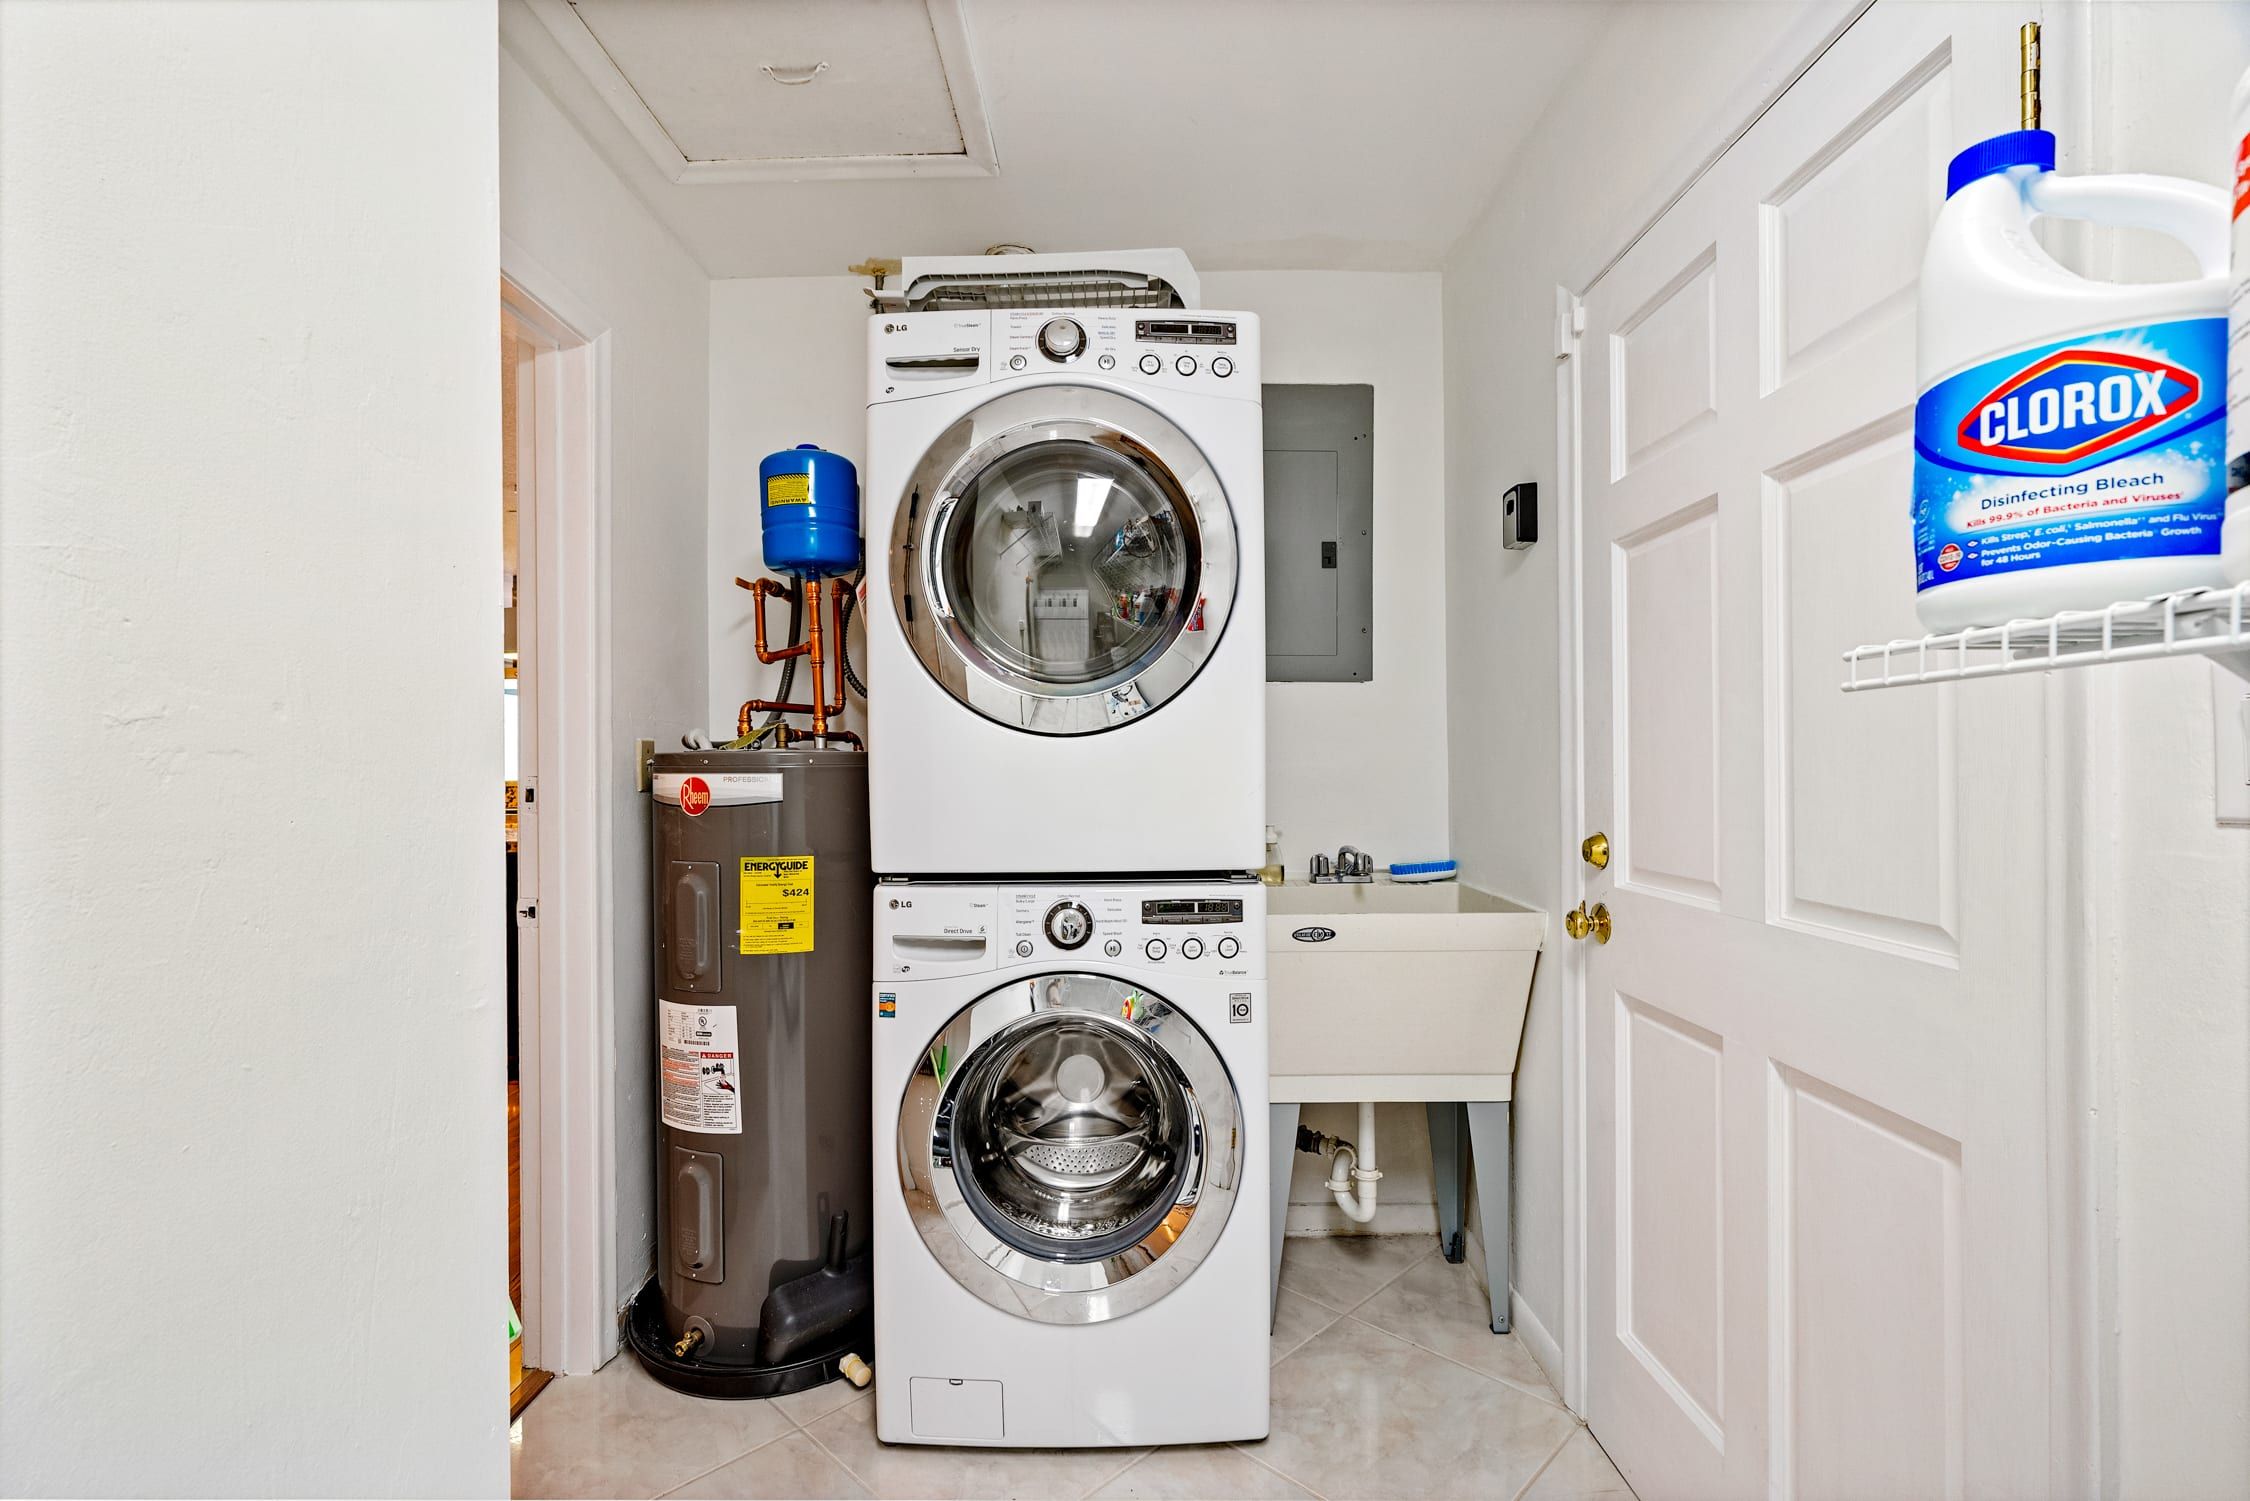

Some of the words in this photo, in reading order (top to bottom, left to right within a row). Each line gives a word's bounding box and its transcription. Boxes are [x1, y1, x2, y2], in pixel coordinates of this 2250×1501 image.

[896, 324, 908, 332] LG
[1979, 369, 2168, 447] CLOROX
[1981, 483, 2088, 510] Disinfecting
[2096, 473, 2164, 491] Bleach
[1966, 517, 1986, 529] Kills
[1989, 511, 2023, 524] 99.9%
[2027, 507, 2040, 517] of
[2043, 499, 2098, 514] Bacteria
[2102, 495, 2128, 507] and
[1981, 535, 1999, 545] Kills
[2034, 527, 2044, 537] E.
[2148, 514, 2170, 524] and
[2172, 513, 2189, 522] Flu
[1981, 545, 2022, 557] Prevents
[2023, 533, 2103, 551] Odor-Causing
[2105, 529, 2154, 542] Bacteria
[2160, 526, 2202, 537] Growth
[1981, 557, 1994, 567] for
[1995, 555, 2009, 564] 48
[2010, 552, 2041, 563] Hours
[683, 778, 709, 810] Rheem
[744, 861, 808, 872] ENERGYGUIDE
[782, 888, 809, 897] $424
[1232, 1003, 1249, 1017] 10
